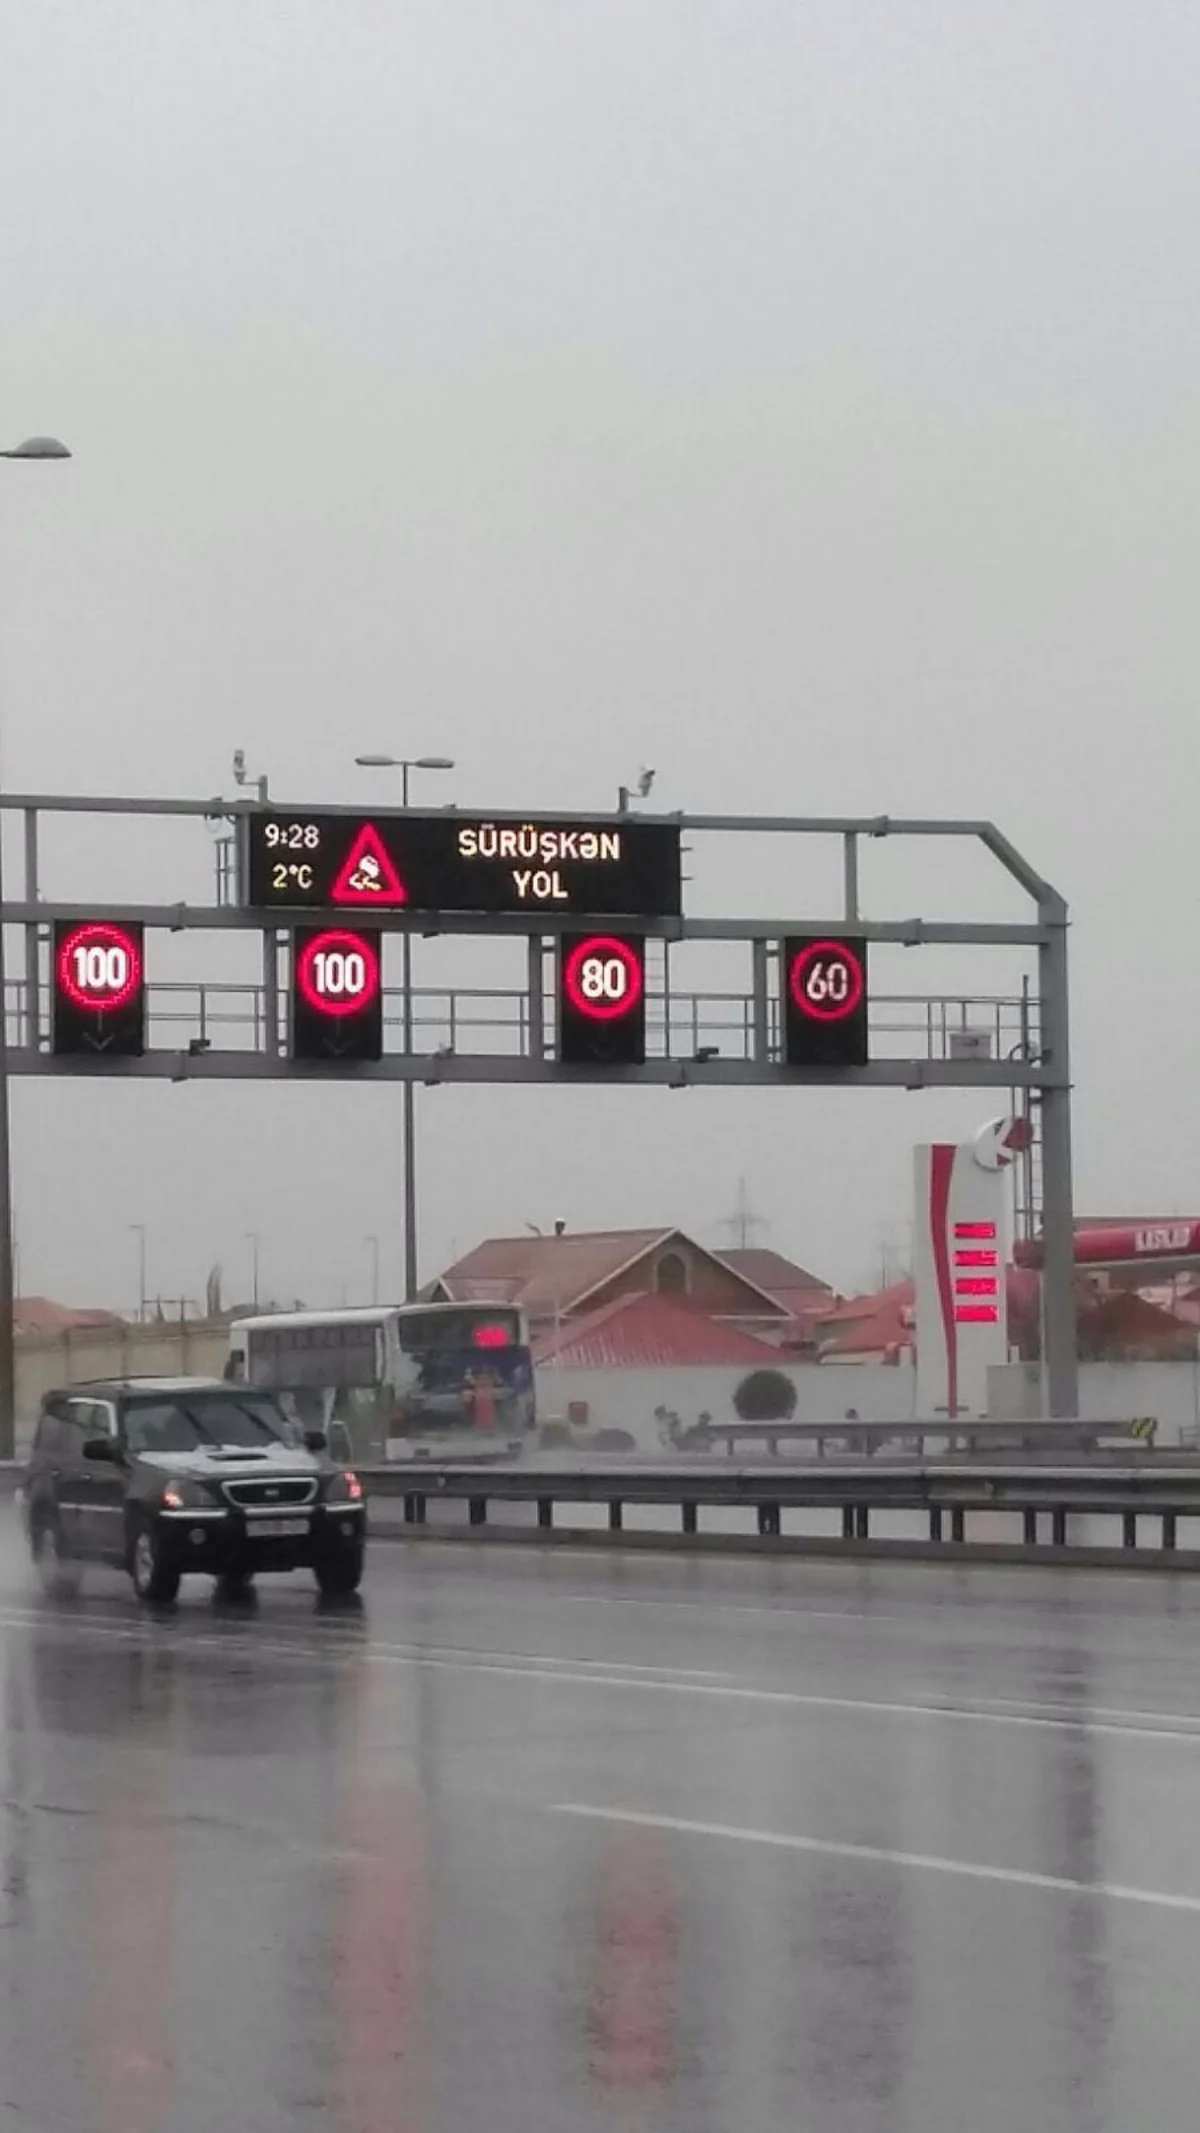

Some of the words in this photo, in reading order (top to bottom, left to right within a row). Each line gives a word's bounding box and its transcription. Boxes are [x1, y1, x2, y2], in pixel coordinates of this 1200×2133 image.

[264, 823, 320, 849] 9:28
[458, 821, 620, 863] SÜRÜŞKƏN
[272, 863, 313, 889] 2°C
[512, 870, 569, 899] YOL
[74, 947, 126, 988] 100
[313, 953, 365, 993] 100
[581, 959, 626, 998] 80
[805, 962, 849, 1001] 60
